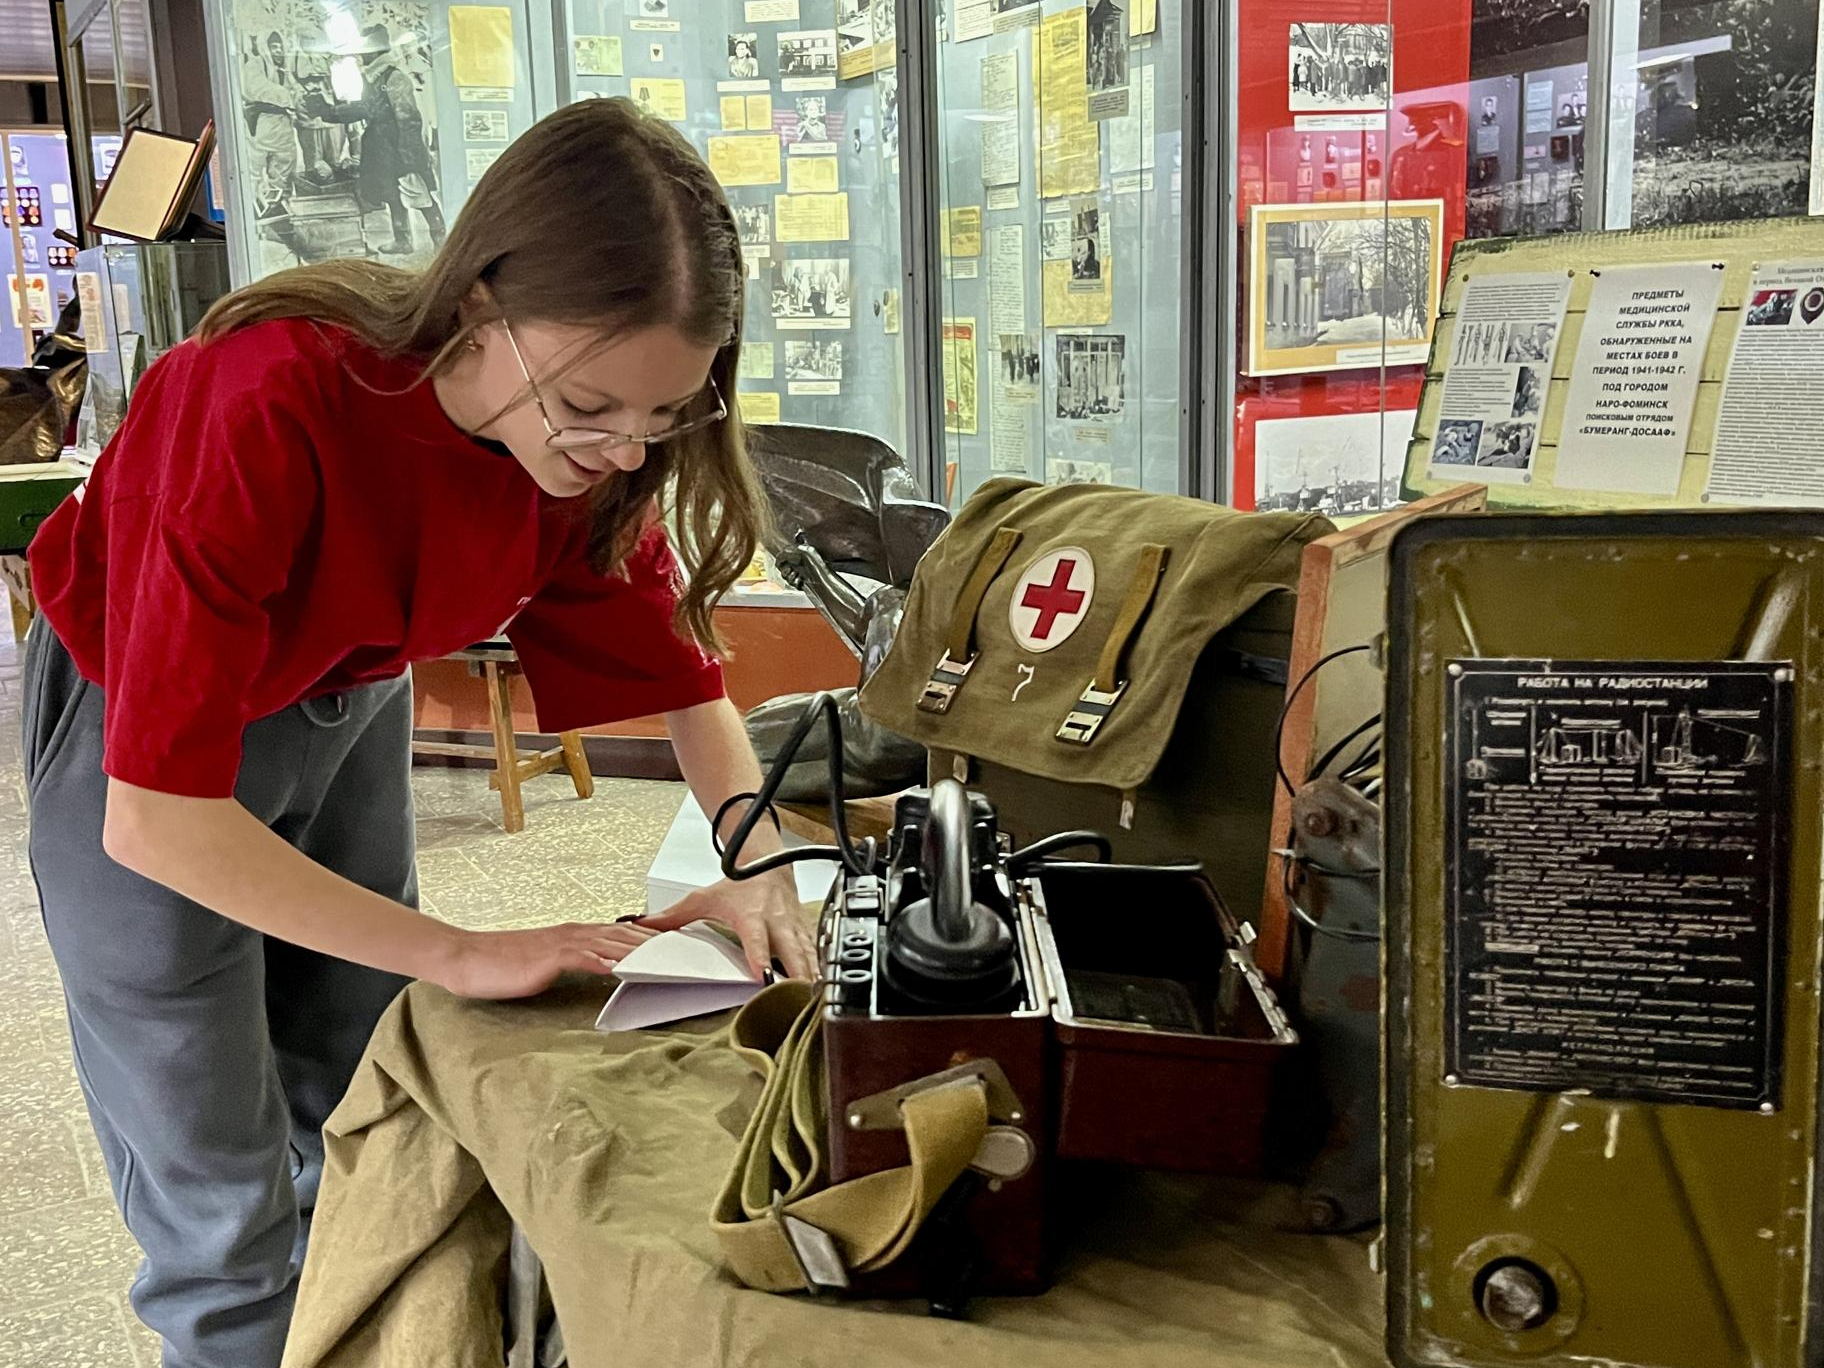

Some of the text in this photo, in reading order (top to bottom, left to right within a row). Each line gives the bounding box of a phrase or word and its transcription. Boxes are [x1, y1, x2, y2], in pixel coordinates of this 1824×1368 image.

[1632, 290, 1684, 300] ПРЕДМЕТЫ
[1619, 303, 1690, 315] МЕДИЦИНСКОЙ
[1616, 320, 1684, 329] СЛУЖБЫ РККА,
[1600, 336, 1692, 346] ОБНАРУЖЕННЫЕ НА
[1606, 351, 1678, 360] МЕСТАХ БОЕВ В
[1592, 366, 1629, 375] ПЕРИОД
[1632, 366, 1675, 374] 1941-1942
[1602, 383, 1668, 392] ПОД ГОРОДОМ
[1596, 400, 1668, 409] НАРО-ФОМИНСК
[1586, 413, 1673, 422] ПОИСКОВЫМ ОТРЯДОМ
[1579, 426, 1676, 437] «БУМЕРАНГ-ДОСААФ»
[1011, 663, 1035, 701] 7
[1518, 677, 1708, 689] РАБОТА НА РАДИОСТАНЦИИ
